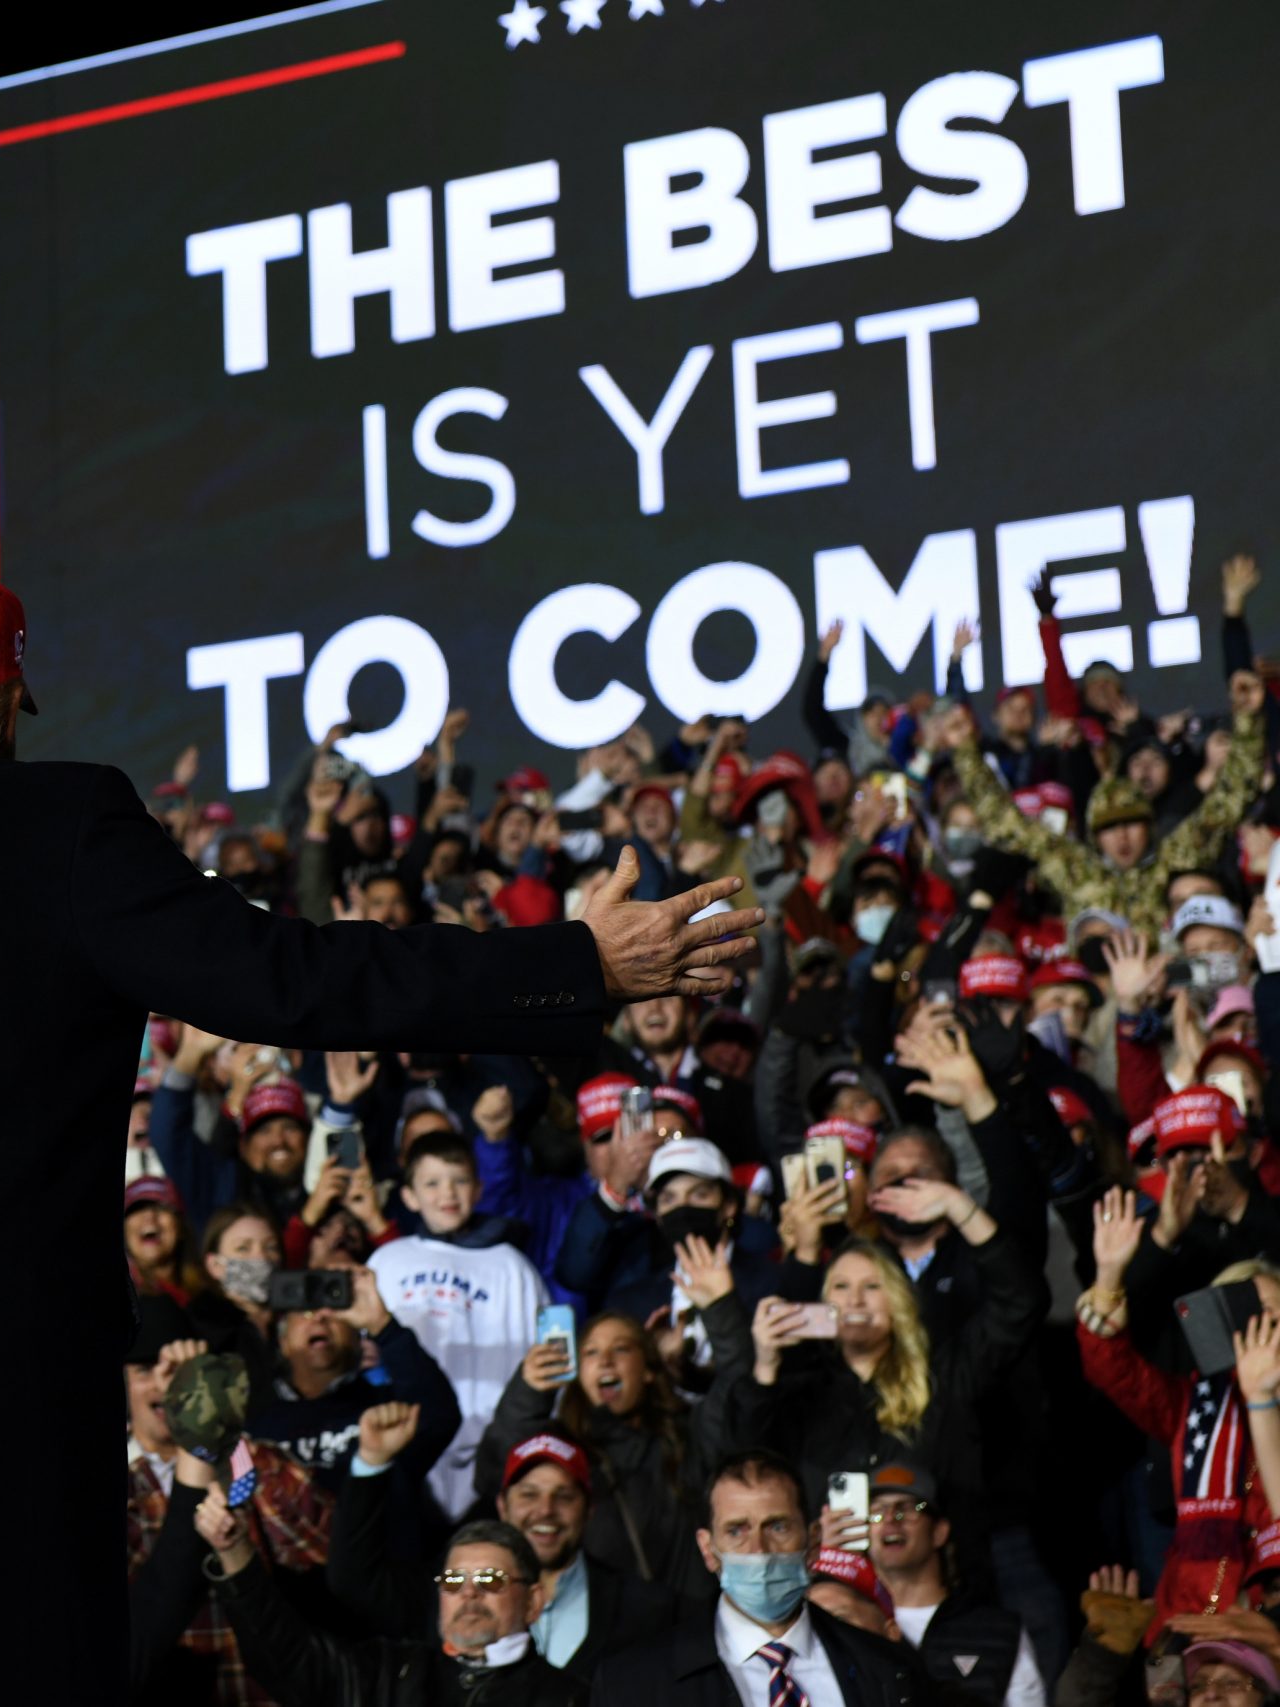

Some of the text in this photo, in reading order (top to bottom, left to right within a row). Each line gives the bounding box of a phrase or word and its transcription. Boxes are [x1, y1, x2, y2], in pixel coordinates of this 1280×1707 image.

[186, 36, 1165, 374] THE BEST
[363, 298, 979, 557] IS YET
[187, 496, 1202, 792] TO COME!
